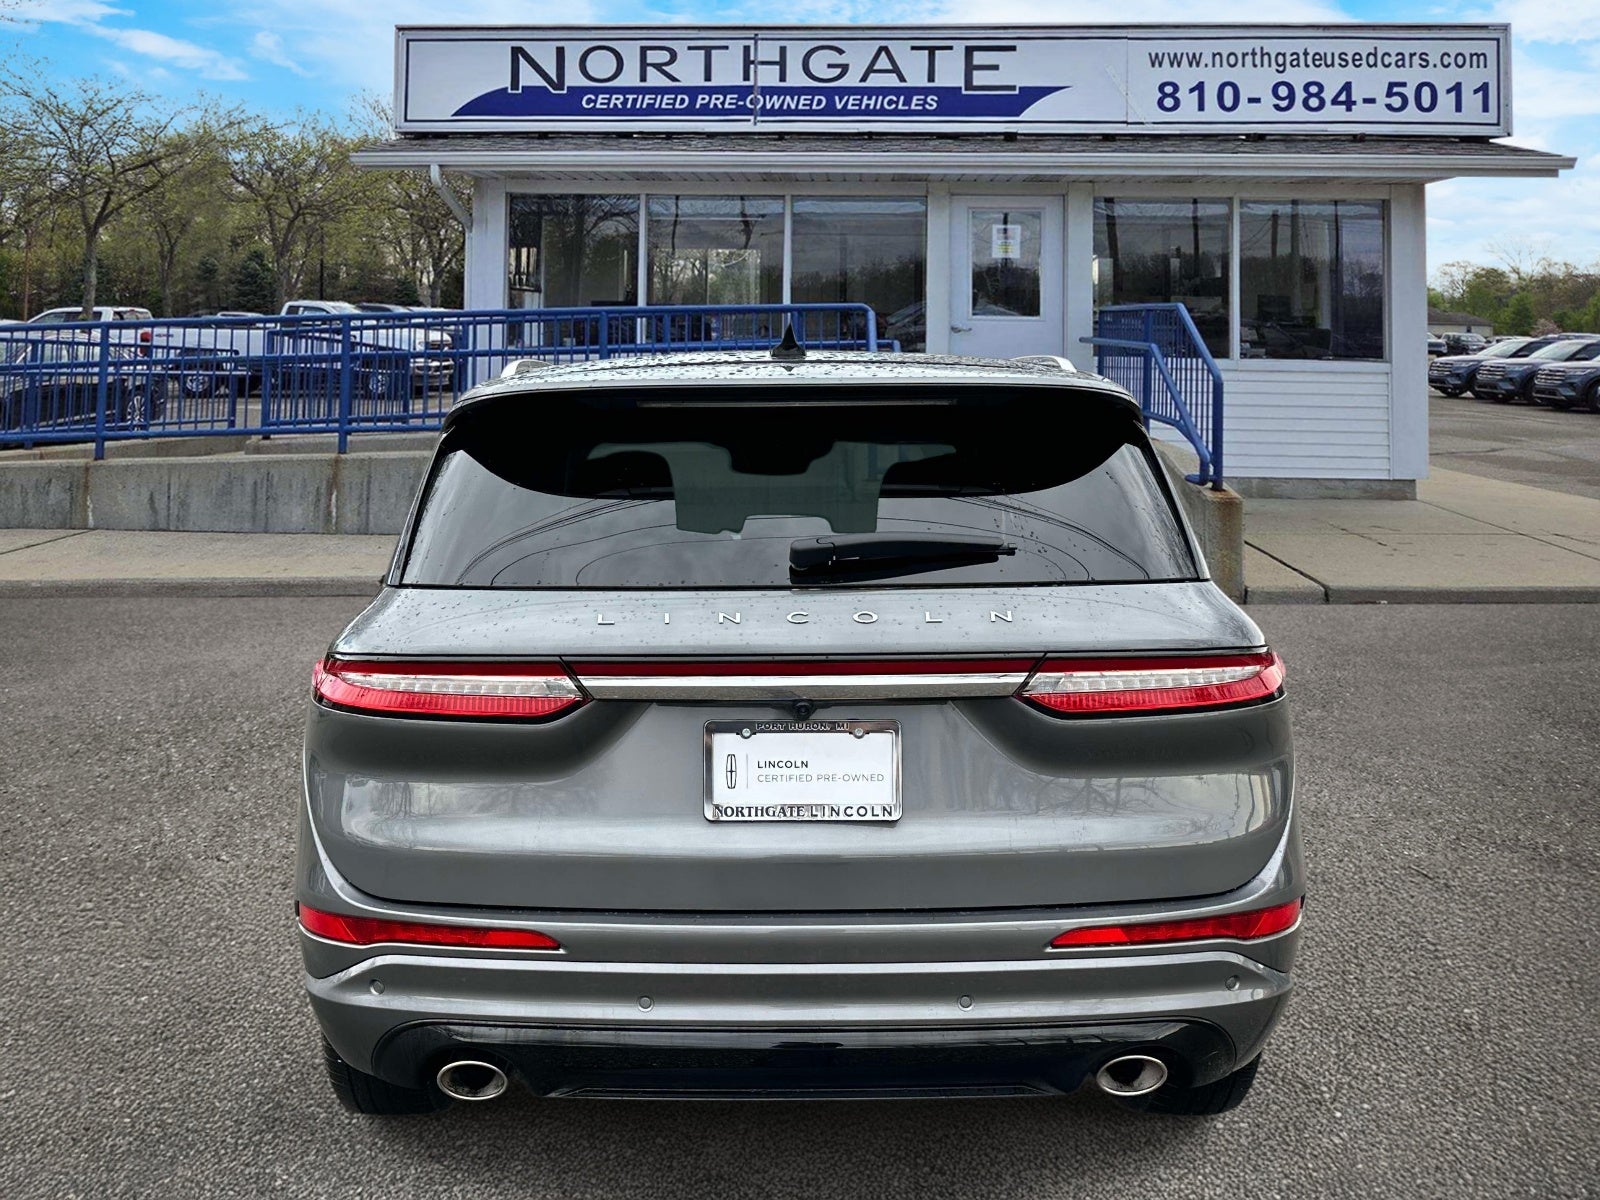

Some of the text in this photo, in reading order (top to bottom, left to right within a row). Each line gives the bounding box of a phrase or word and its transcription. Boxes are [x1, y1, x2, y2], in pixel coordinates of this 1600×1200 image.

[1149, 47, 1488, 73] www.northgateusedcars.com
[508, 44, 1018, 93] NORTHGATE
[581, 93, 939, 111] CERTIFIED PRE-OWNED VEHICLES
[1156, 80, 1492, 113] 810-984-5011
[597, 610, 1014, 626] LINCOLN
[756, 722, 785, 731] PORT
[836, 722, 850, 731] MI
[757, 760, 809, 769] LINCOLN
[757, 773, 885, 783] CERTIFIED PRE-OWNED
[714, 805, 893, 818] NORTHGATE LINCOLN
